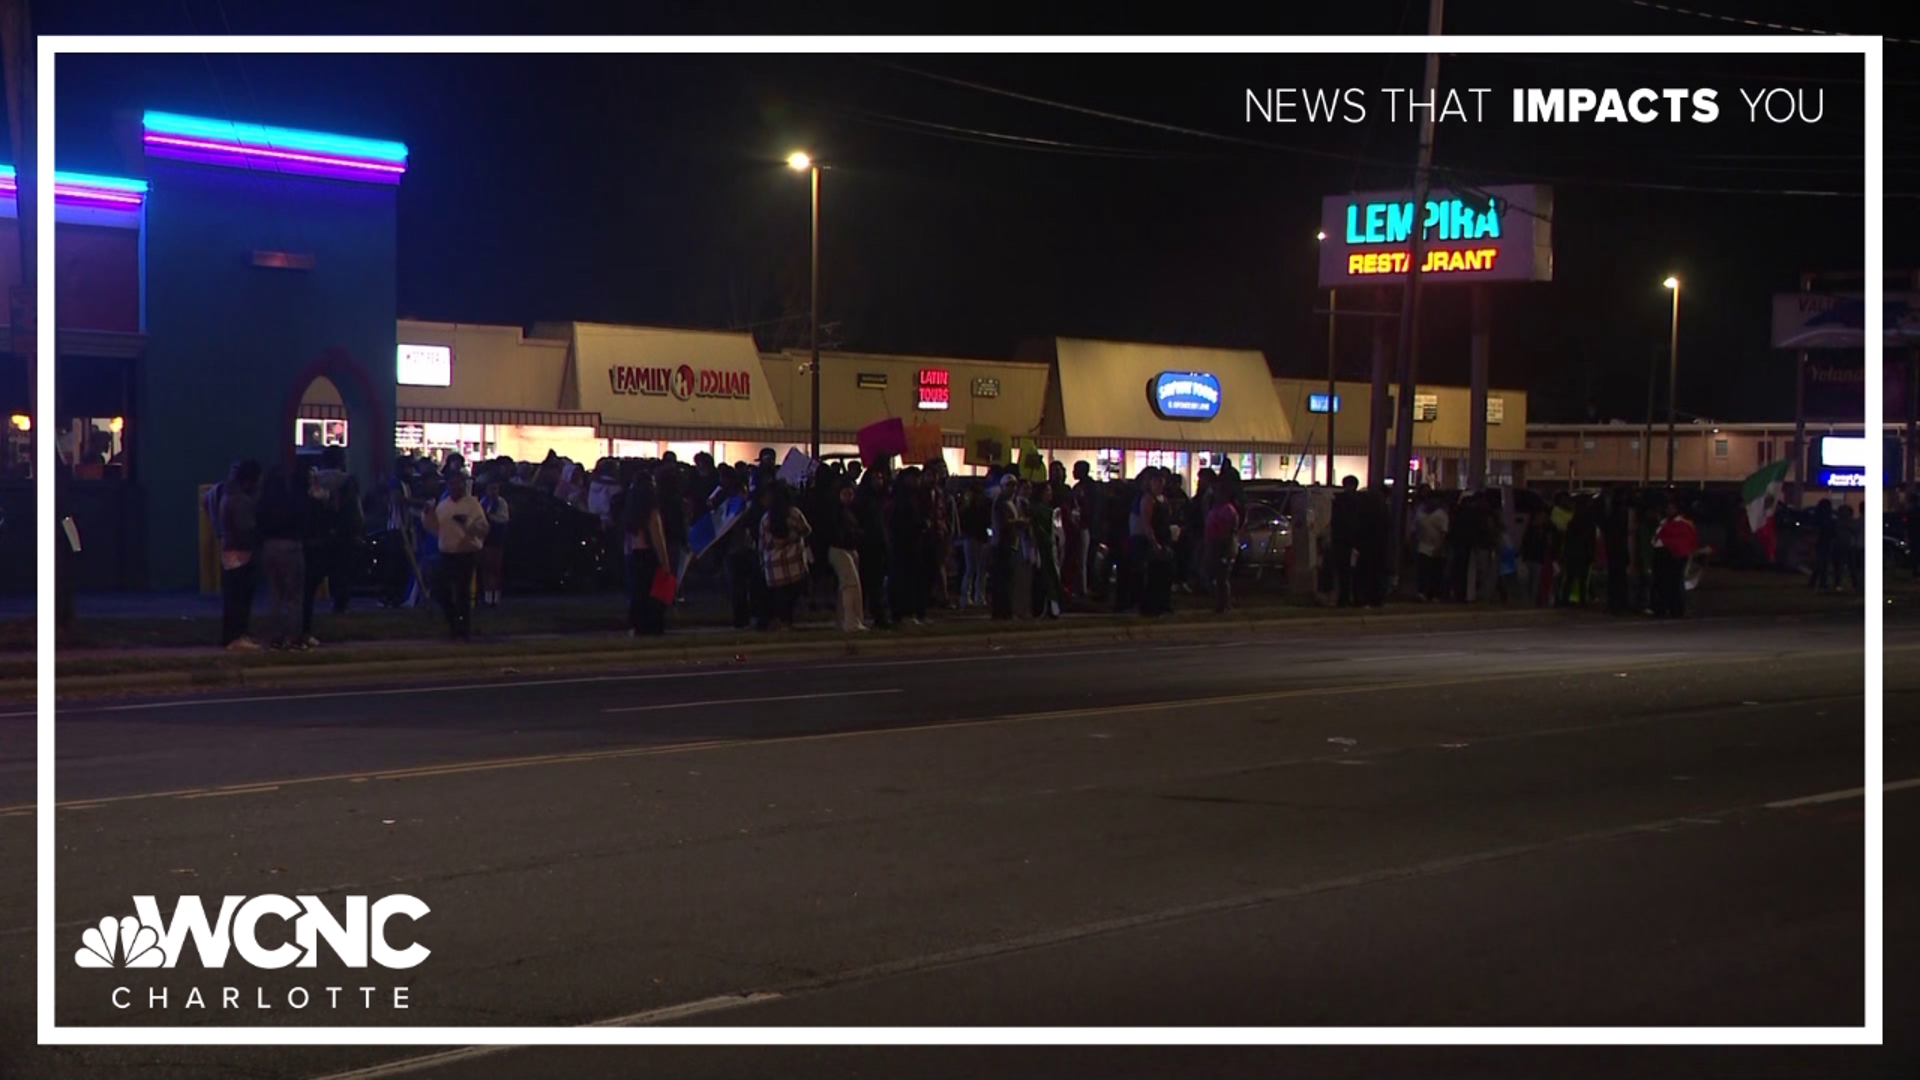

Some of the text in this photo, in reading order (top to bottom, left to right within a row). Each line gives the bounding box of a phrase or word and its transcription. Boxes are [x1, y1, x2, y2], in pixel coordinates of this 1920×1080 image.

[1346, 199, 1500, 244] LEMPIRA
[1348, 249, 1496, 275] RESTURANT
[613, 365, 750, 396] FAMILY DOLLAR
[919, 369, 949, 386] LATIN
[918, 387, 949, 402] TOURS
